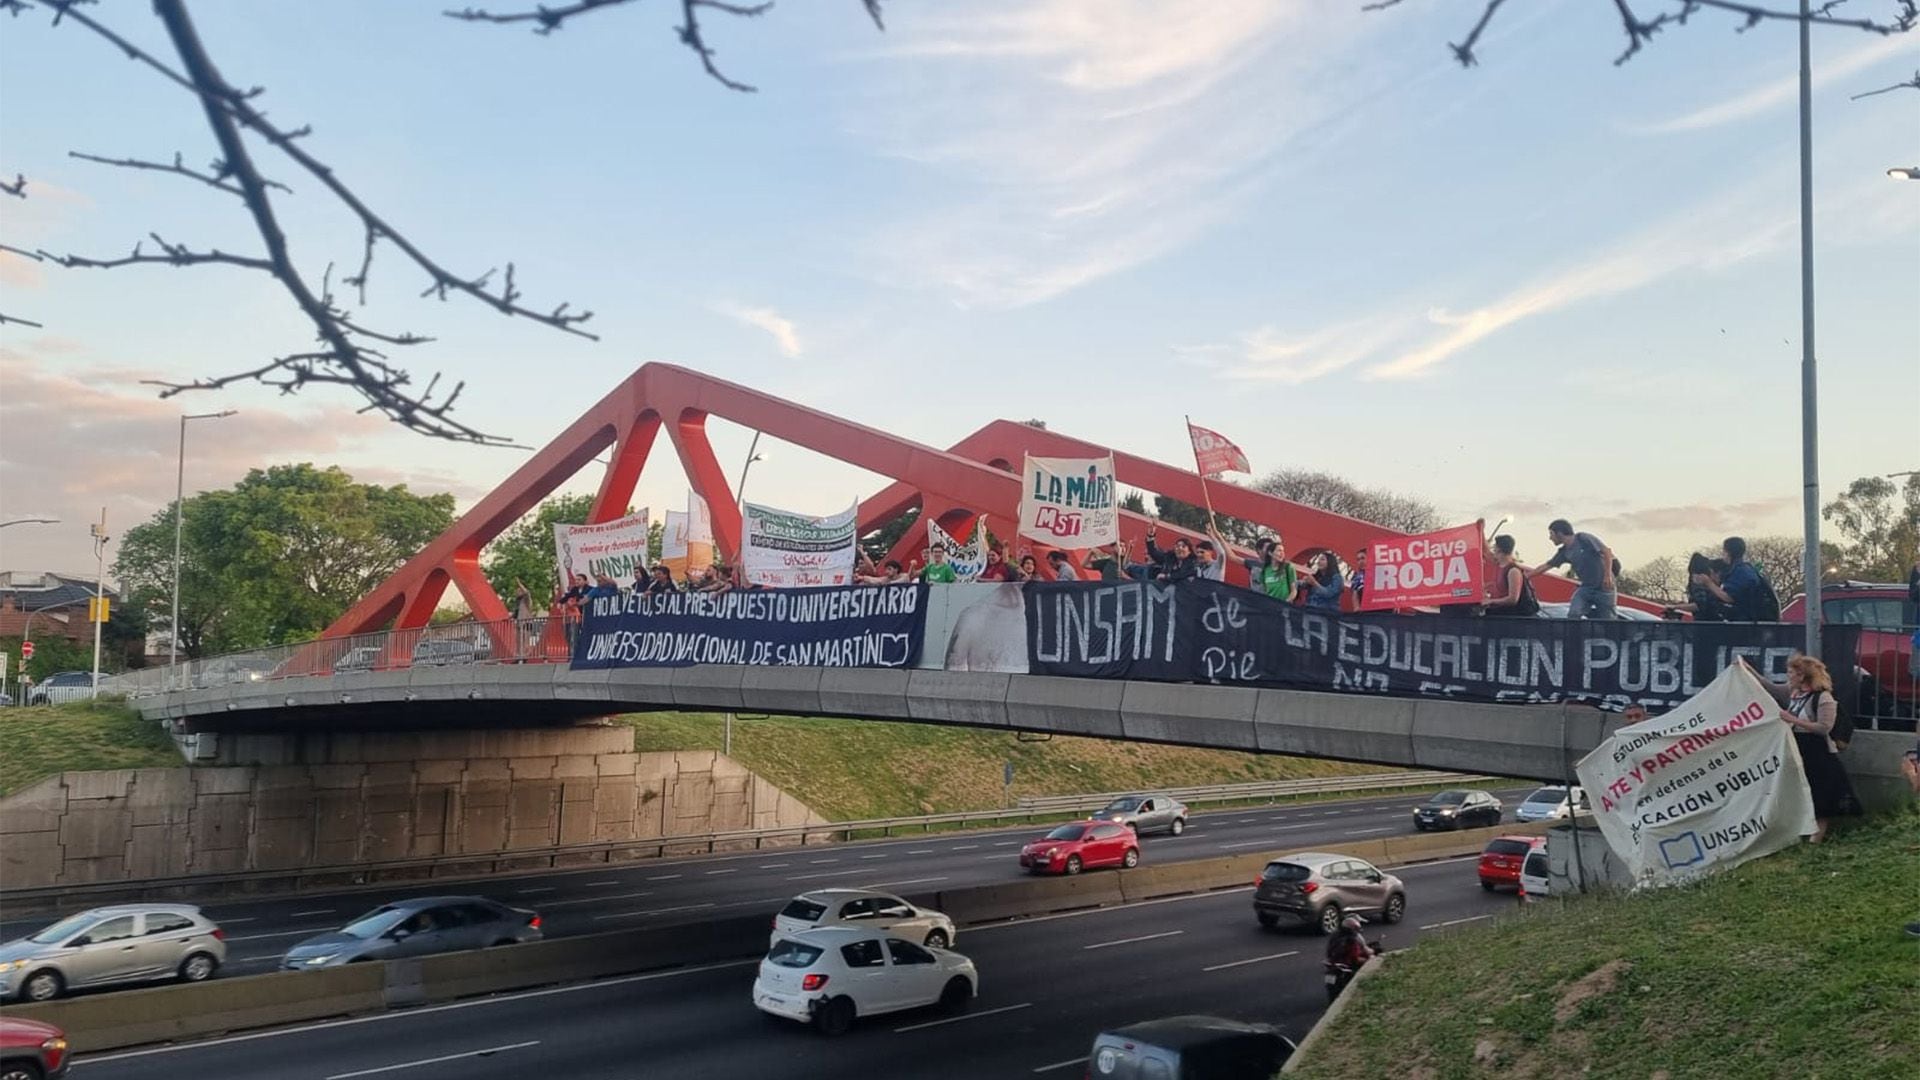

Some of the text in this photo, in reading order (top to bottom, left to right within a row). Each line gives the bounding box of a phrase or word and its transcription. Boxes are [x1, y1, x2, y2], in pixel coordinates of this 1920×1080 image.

[1034, 471, 1062, 504] LA
[1036, 506, 1082, 537] MST
[1374, 539, 1468, 564] En Clave
[1374, 556, 1471, 591] ROJA
[593, 597, 608, 618] NO
[609, 594, 620, 616] AL
[666, 594, 682, 616] AL
[684, 592, 788, 622] PRESUPUESTO
[789, 585, 918, 623] UNIVERSITARIO
[587, 628, 880, 667] UNIVERSIDAD NACIONAL DE SAN MARTÍN
[1035, 583, 1176, 664] UNSAM
[1202, 591, 1247, 633] de
[1282, 607, 1329, 656] LA
[1338, 620, 1564, 688] EDUCACION
[1202, 646, 1260, 684] Pie
[1689, 712, 1706, 728] DE
[1629, 767, 1644, 784] Y
[1641, 702, 1765, 774] PATRIMONIO
[1656, 766, 1707, 799] defensa
[1708, 758, 1724, 771] de
[1724, 750, 1738, 762] la
[1715, 755, 1781, 798] PÚBLICA
[1701, 815, 1768, 851] UNSAM
